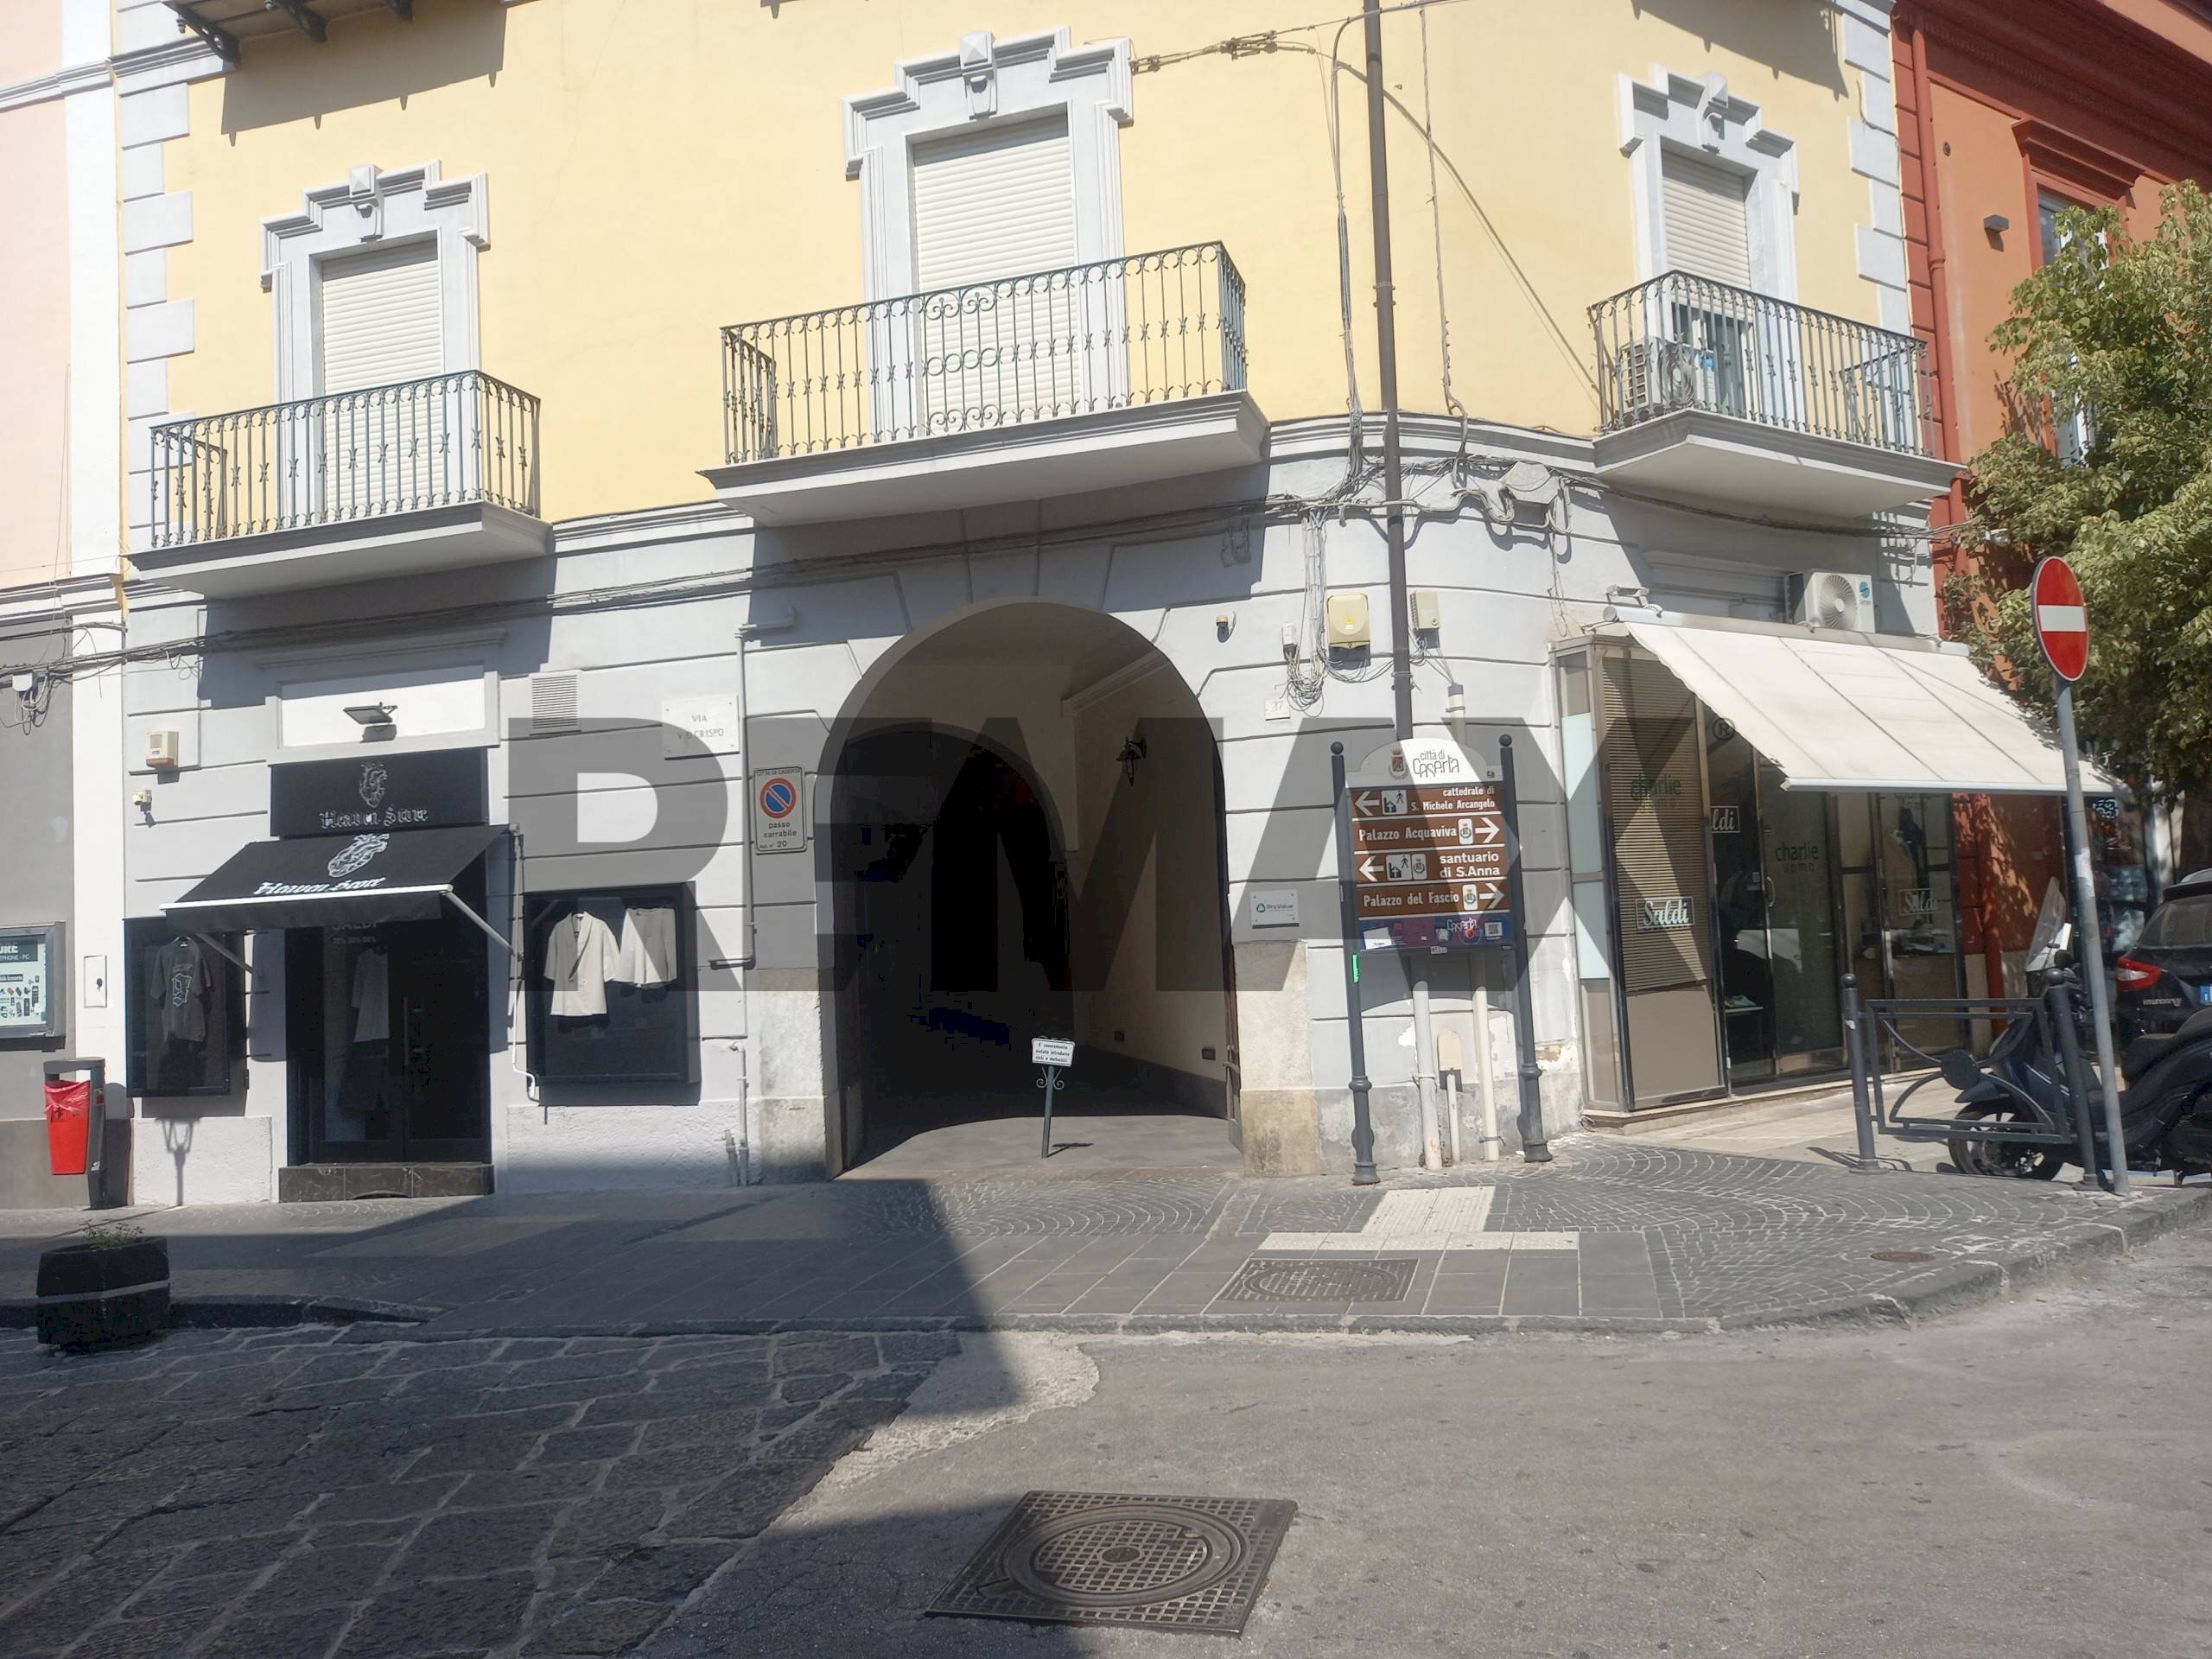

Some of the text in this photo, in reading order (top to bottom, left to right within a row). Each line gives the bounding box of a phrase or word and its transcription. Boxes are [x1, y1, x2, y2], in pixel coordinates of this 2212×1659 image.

[1439, 749, 1445, 760] di
[1413, 755, 1459, 777] Caserta
[1443, 785, 1495, 796] cattedrale di
[1411, 798, 1496, 811] S. Michele Arcangelo
[763, 830, 798, 838] carrabile
[1358, 825, 1457, 842] Palazzo Acquaviva
[1440, 851, 1499, 864] santuario
[1776, 842, 1820, 861] charlie
[1440, 866, 1500, 878] di S.Anna
[1363, 892, 1459, 907] Palazzo del Fascio
[1643, 899, 1689, 926] Saldi
